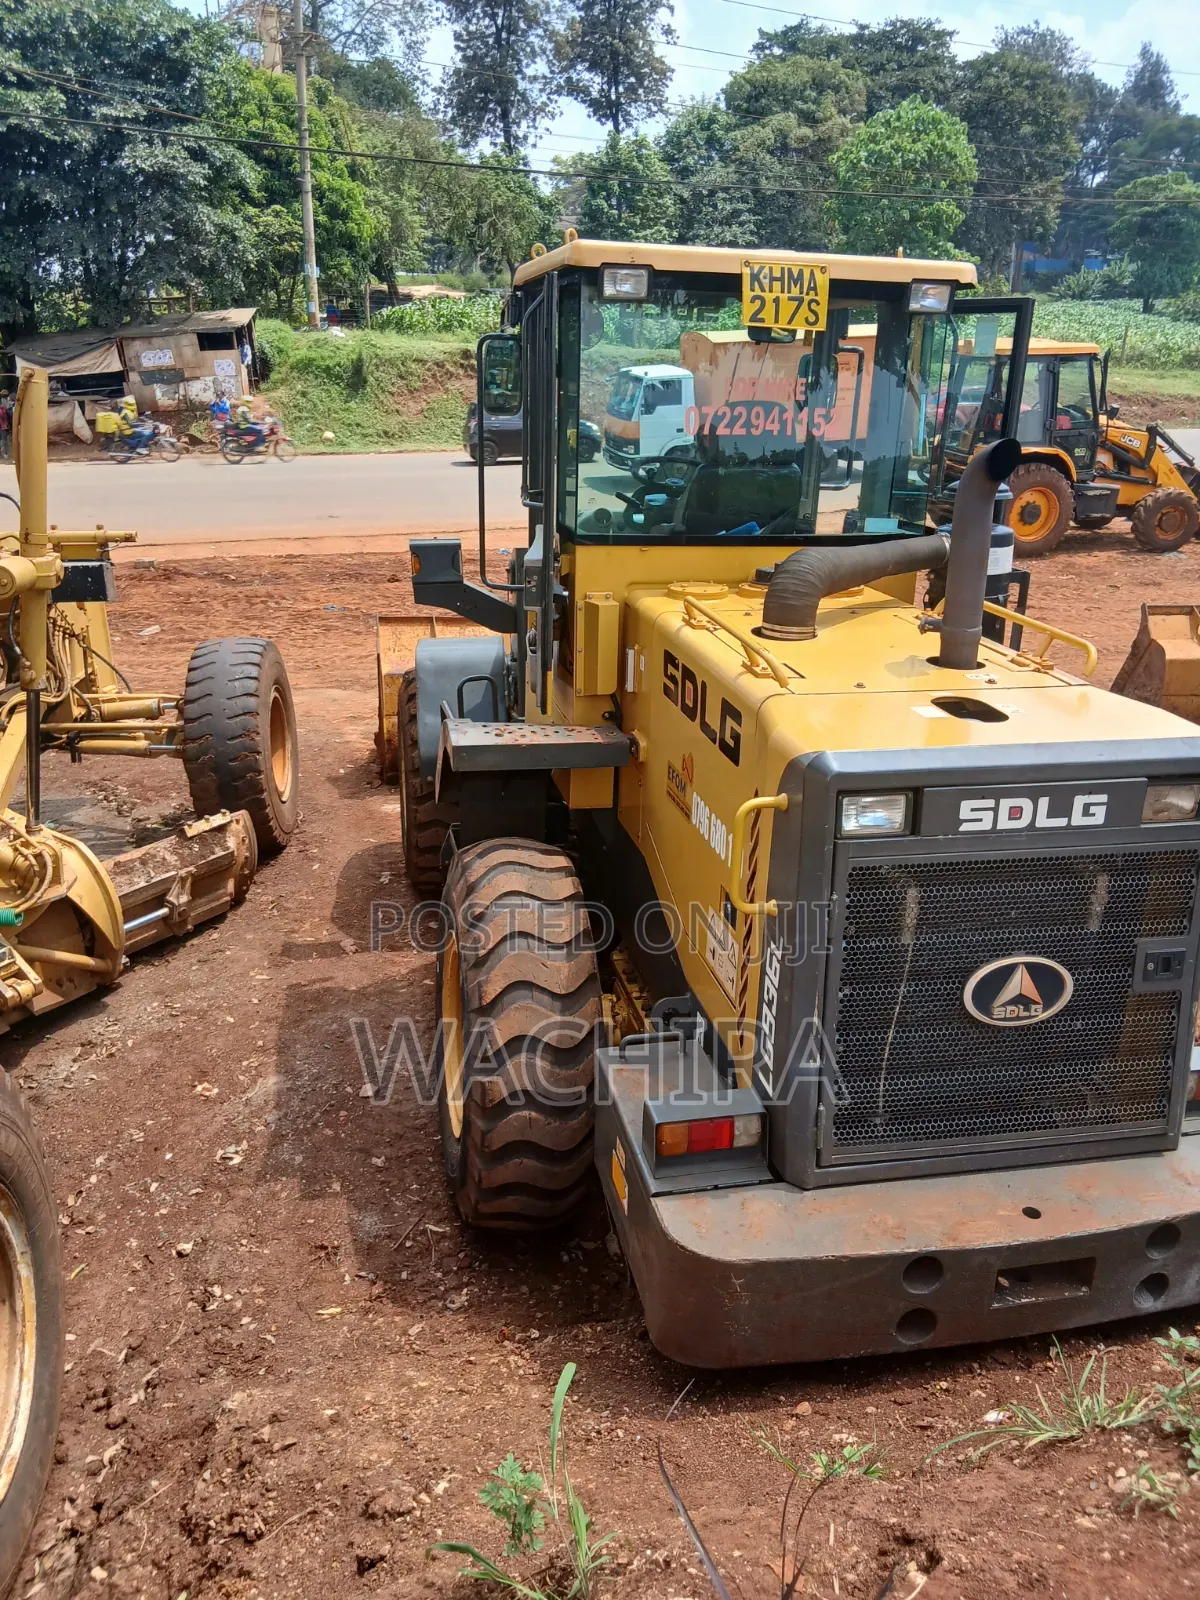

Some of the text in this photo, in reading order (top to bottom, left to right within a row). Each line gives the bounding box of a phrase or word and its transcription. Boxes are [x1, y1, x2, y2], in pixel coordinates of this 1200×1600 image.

[749, 265, 819, 297] KHMA
[748, 295, 820, 327] 217S
[1120, 434, 1142, 448] JCB
[663, 649, 743, 768] SDLG
[691, 791, 727, 861] 0796 680
[957, 793, 1109, 832] SDLG
[992, 1004, 1043, 1019] SDLG
